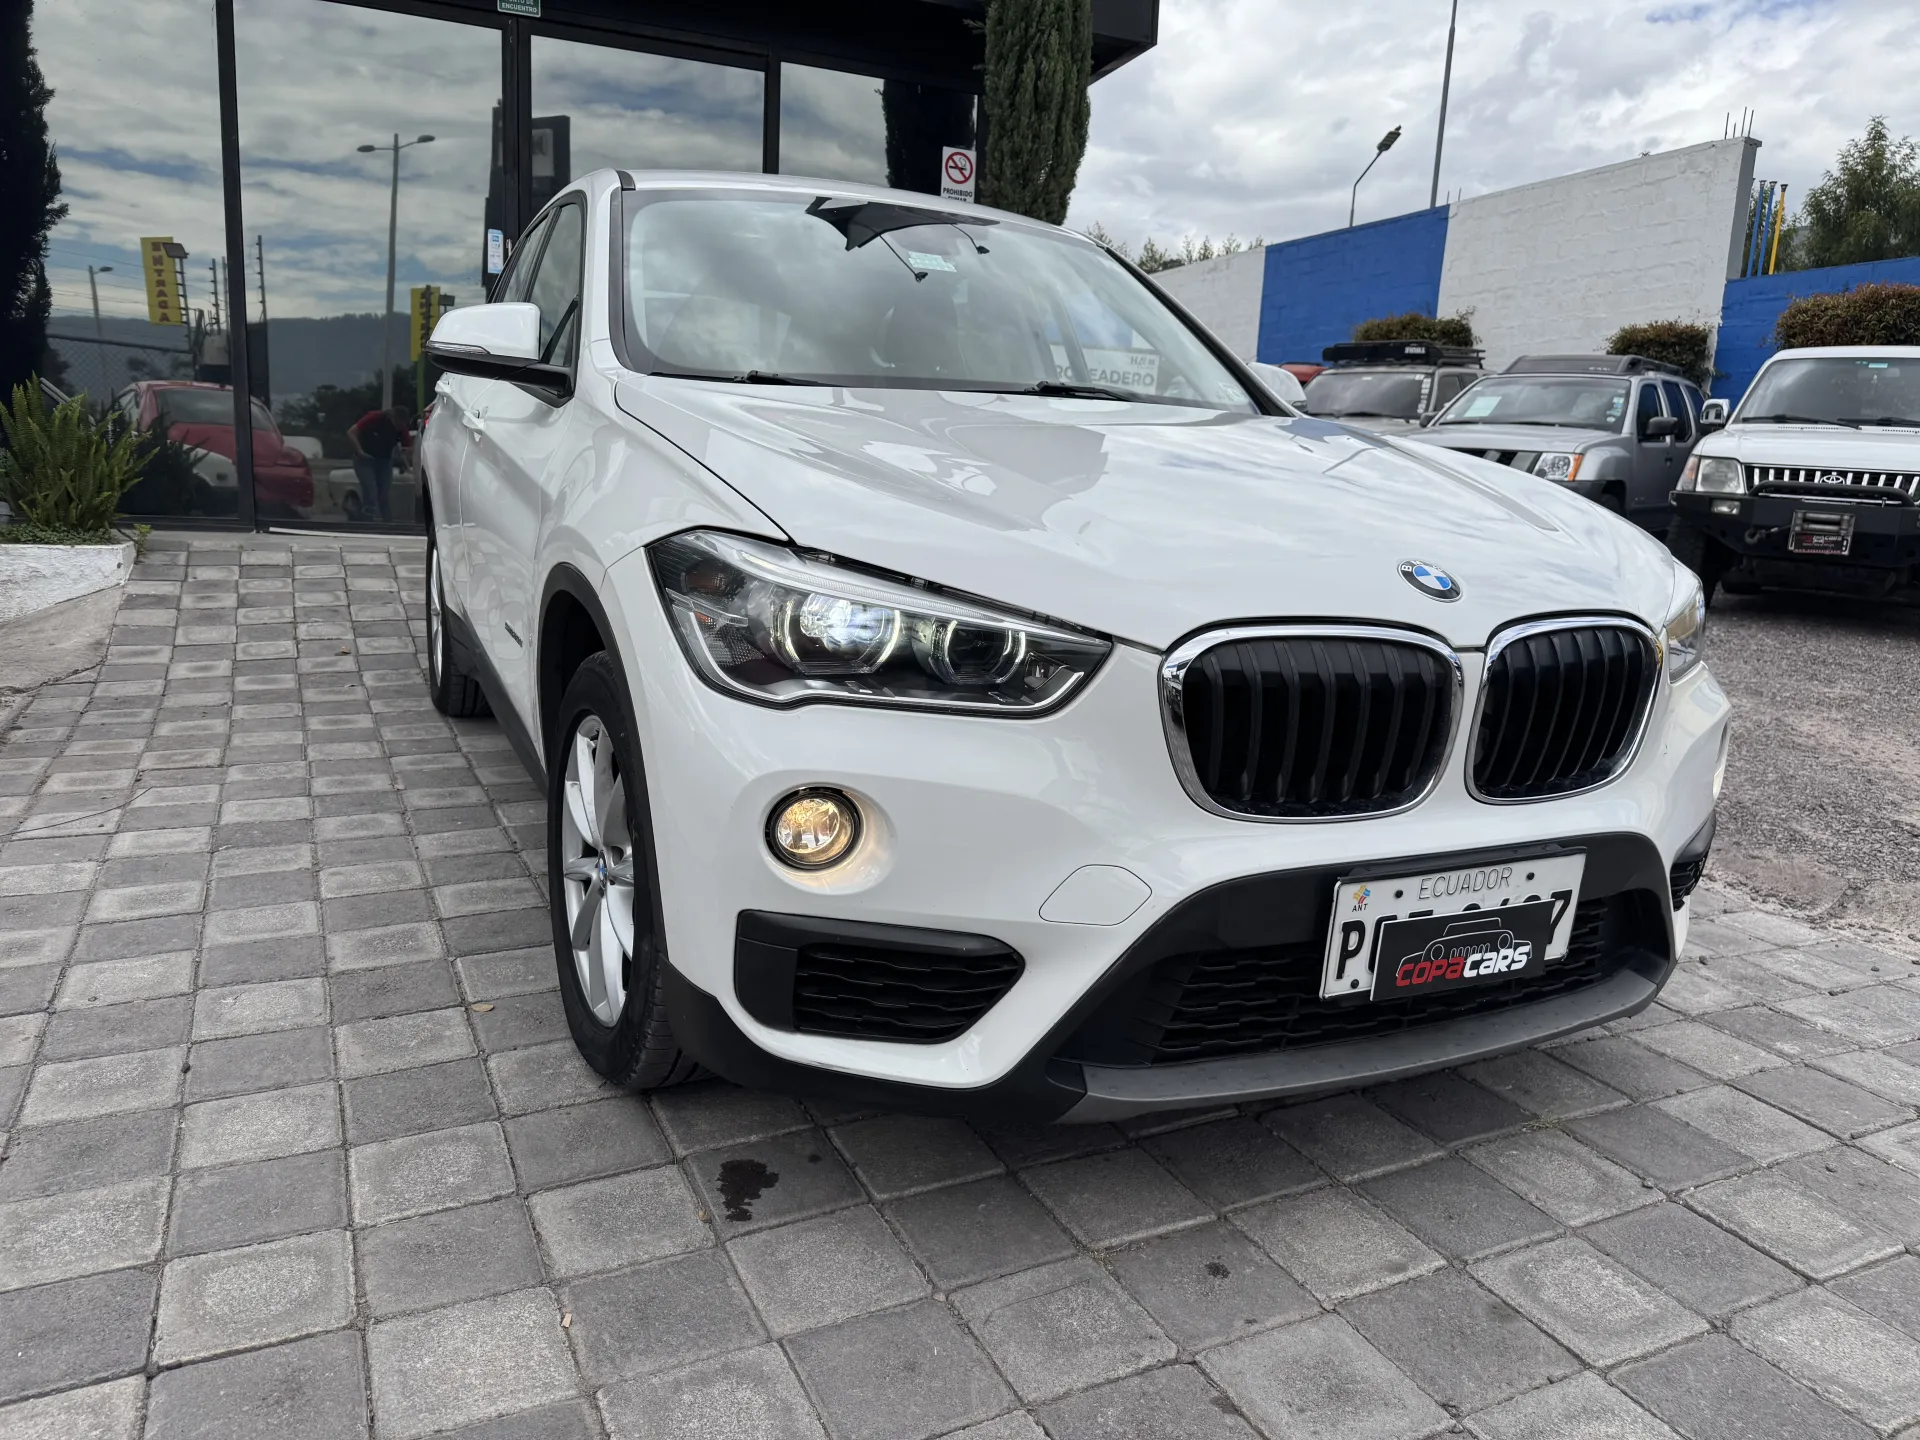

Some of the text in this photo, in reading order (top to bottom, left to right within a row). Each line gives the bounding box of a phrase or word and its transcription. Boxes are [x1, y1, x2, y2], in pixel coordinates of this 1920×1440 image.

[502, 2, 537, 13] ENCUENTRO
[943, 187, 973, 198] PROHIBIDO
[1418, 867, 1513, 900] ECUADOR
[1351, 903, 1368, 912] ANT
